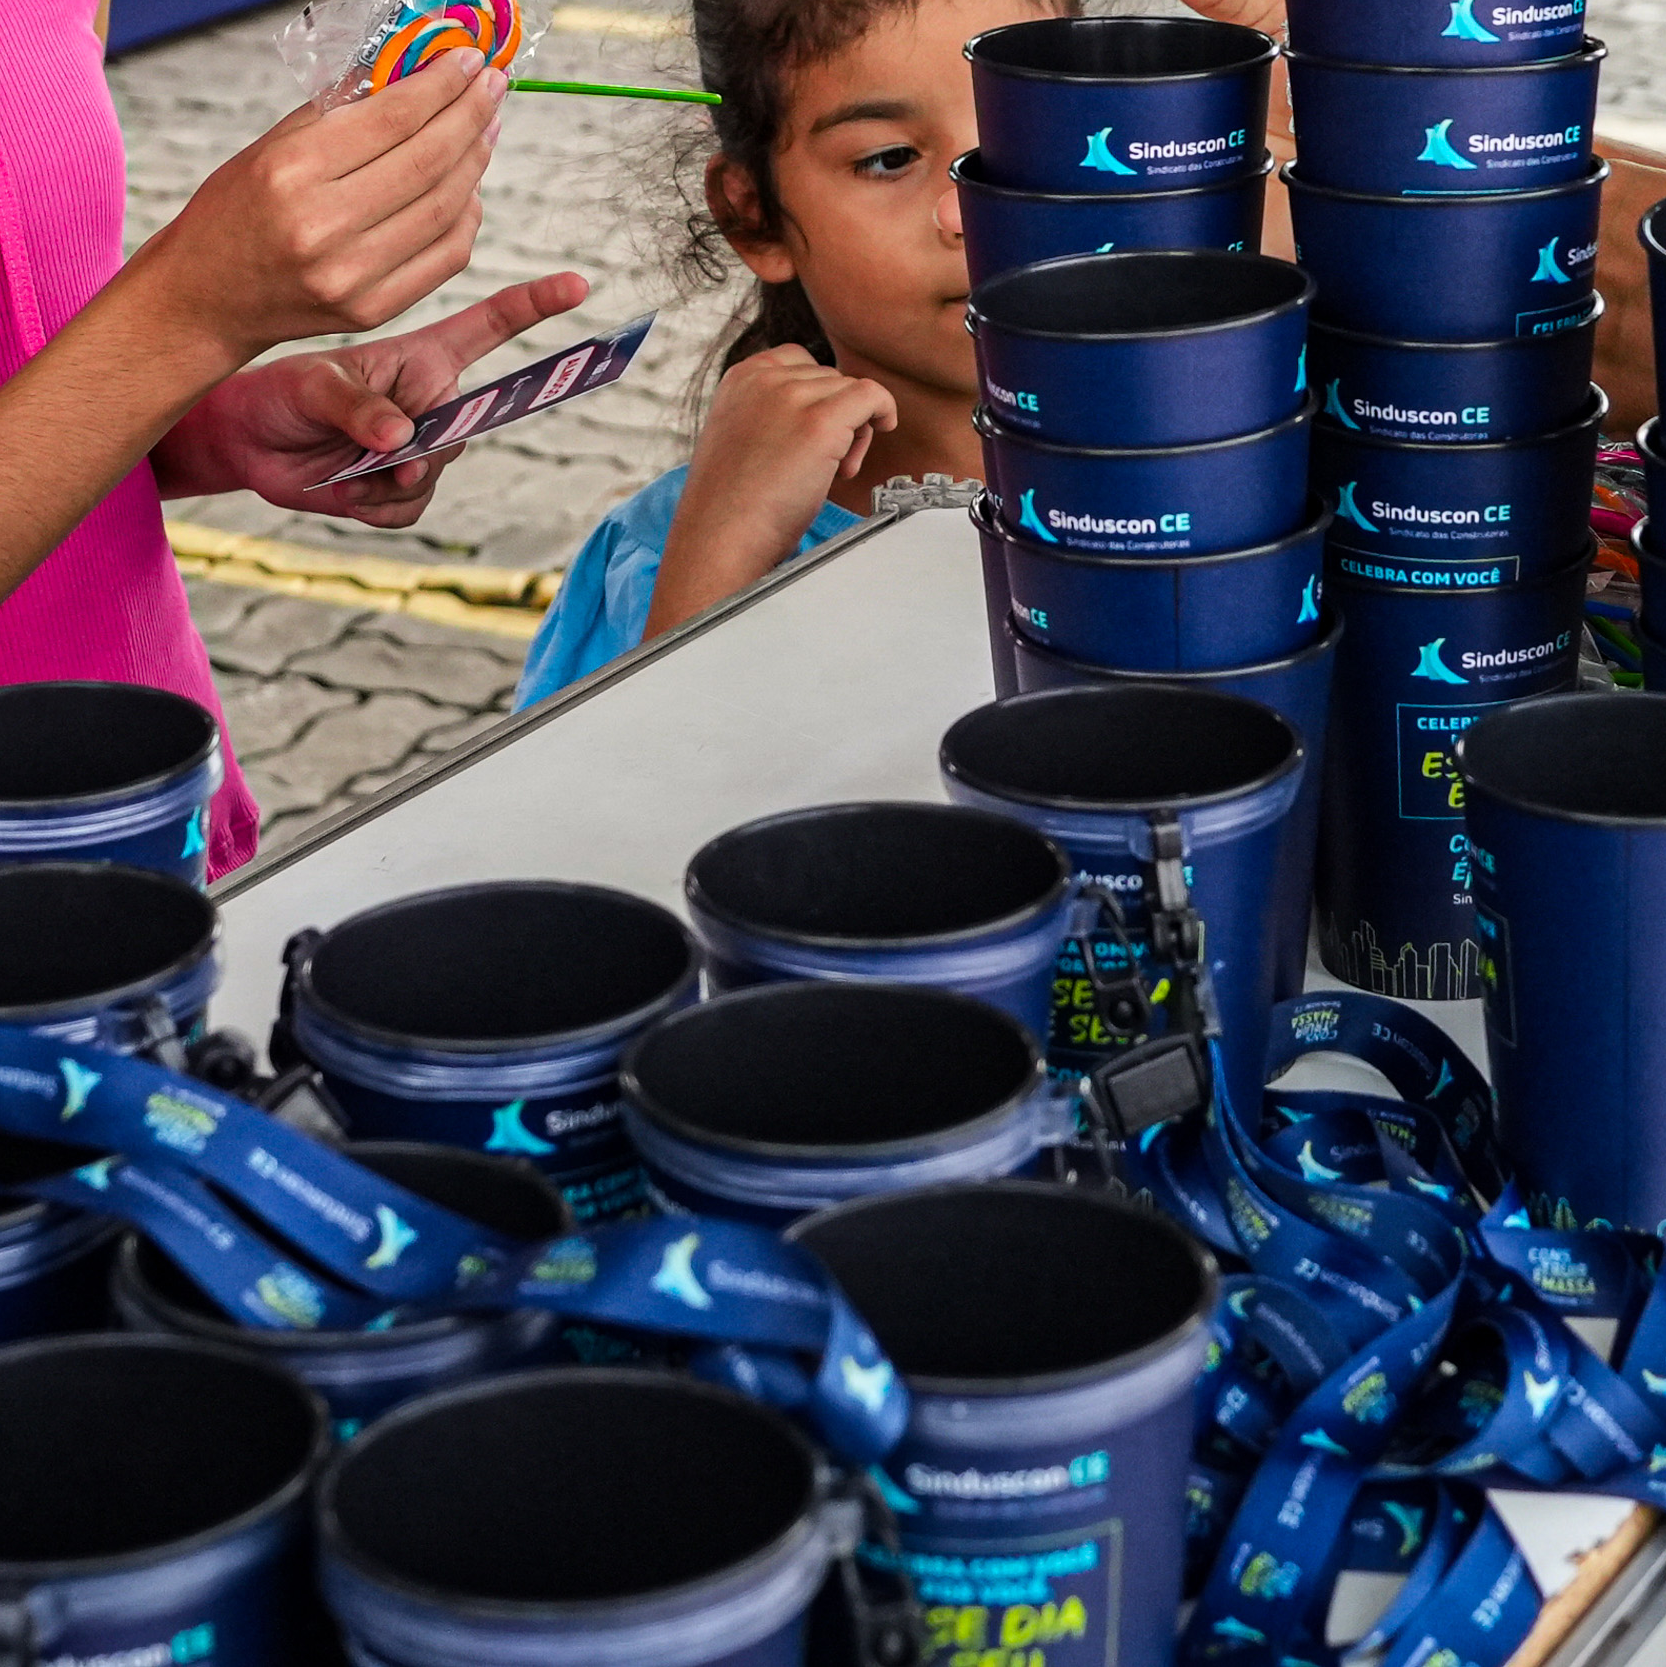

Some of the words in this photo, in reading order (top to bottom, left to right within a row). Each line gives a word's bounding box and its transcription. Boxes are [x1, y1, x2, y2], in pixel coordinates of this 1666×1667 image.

[1491, 2, 1573, 26] Sinduscon
[1129, 137, 1226, 160] Sinduscon
[1228, 129, 1246, 148] CE
[1468, 133, 1563, 153] Sinduscon
[1564, 125, 1581, 144] CE
[1017, 390, 1040, 412] CE
[1353, 398, 1458, 426] Sinduscon
[1461, 406, 1490, 424] CE
[1048, 509, 1157, 535] Sinduscon
[1159, 512, 1192, 532] CE
[1371, 500, 1480, 525] Sinduscon
[1484, 504, 1512, 522] CE
[1341, 558, 1408, 583] CELEBRA
[1410, 570, 1451, 585] COM
[1453, 566, 1501, 584] VOCÊ
[1461, 641, 1555, 669] Sinduscon
